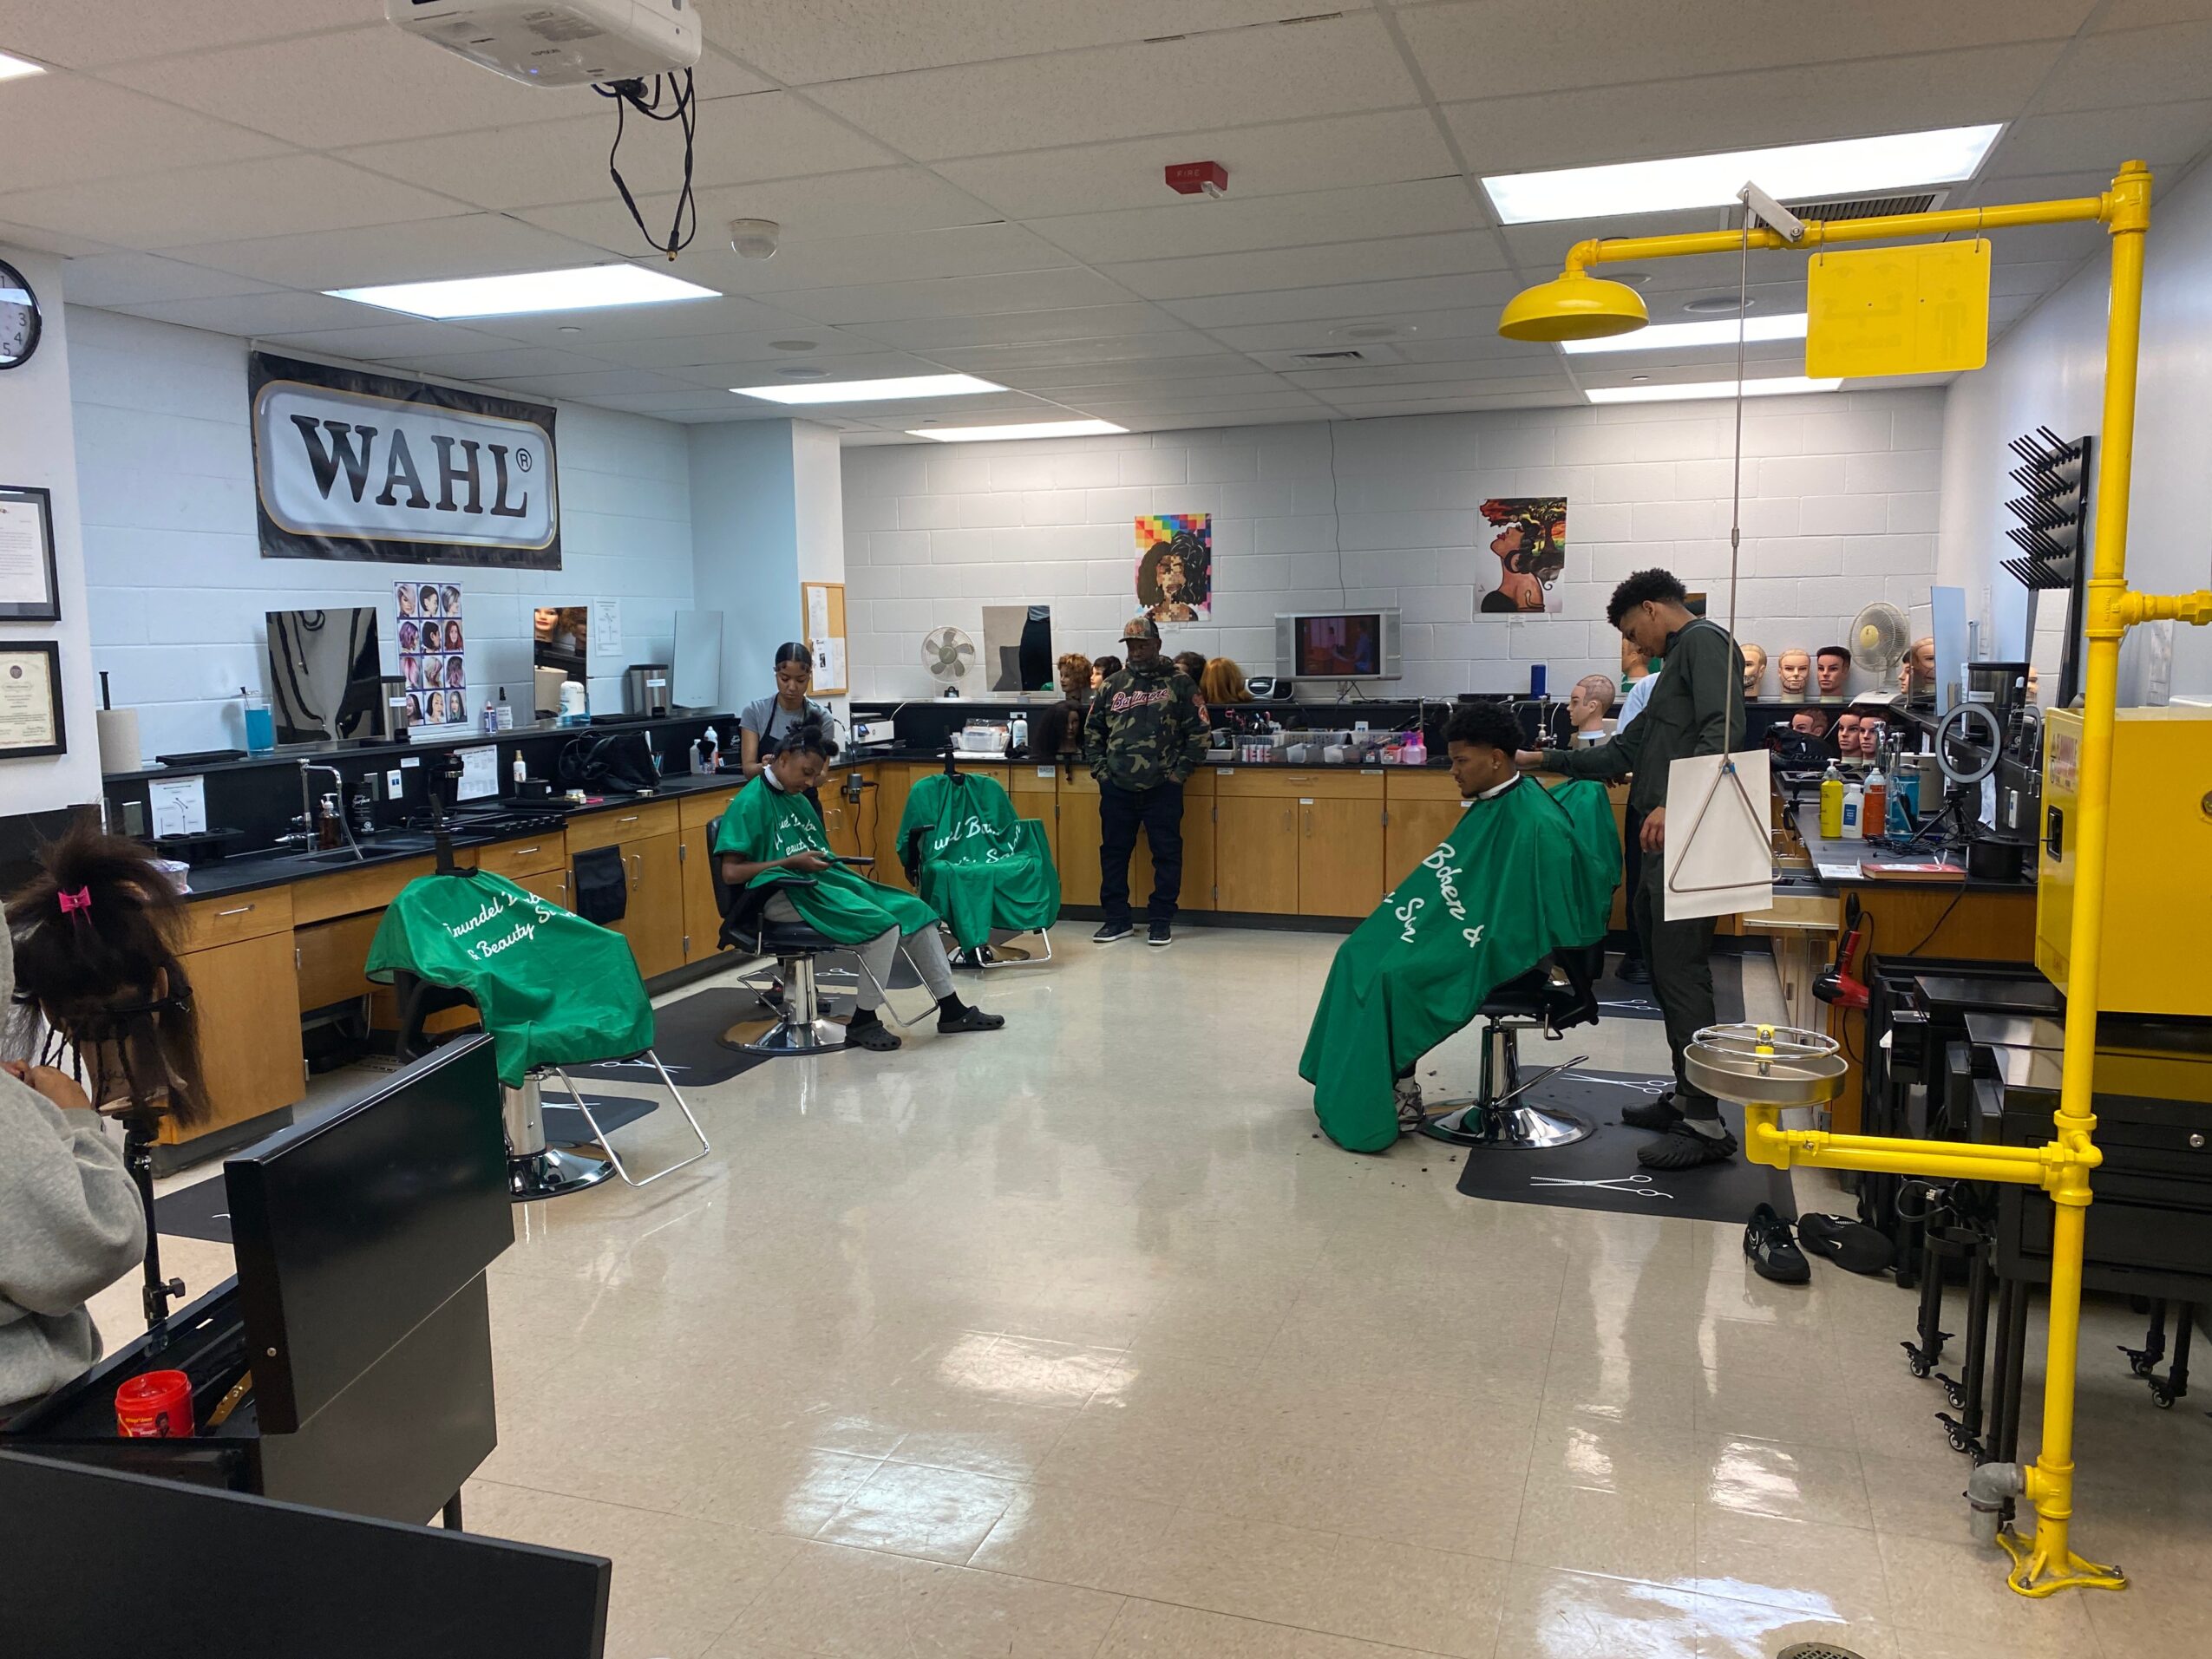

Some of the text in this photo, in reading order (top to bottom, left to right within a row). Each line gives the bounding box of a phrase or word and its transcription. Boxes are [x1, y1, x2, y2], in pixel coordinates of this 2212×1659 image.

[18, 312, 27, 327] 3
[14, 332, 23, 345] 4
[3, 343, 11, 356] 5
[1110, 689, 1169, 713] Baltimore
[467, 949, 482, 961] &
[476, 924, 535, 958] Beauty
